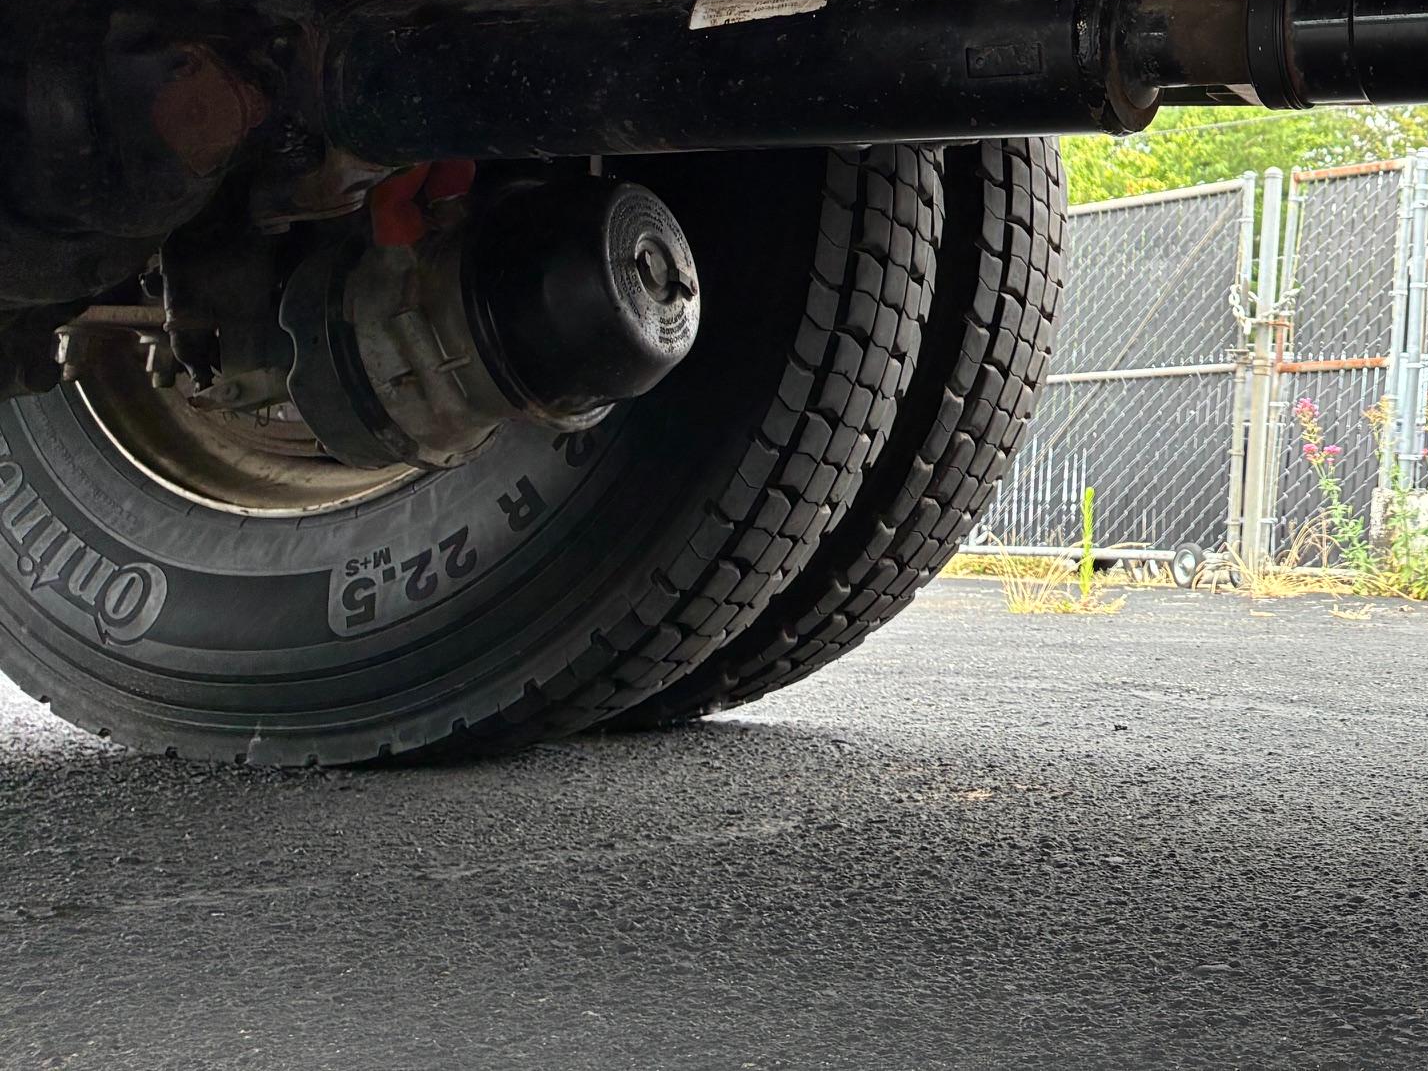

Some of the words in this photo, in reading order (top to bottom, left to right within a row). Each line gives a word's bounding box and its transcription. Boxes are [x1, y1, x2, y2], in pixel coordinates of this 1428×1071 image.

[0, 427, 168, 645] Contine
[497, 475, 548, 532] R
[342, 524, 477, 629] 22.5
[345, 546, 392, 577] M+S
